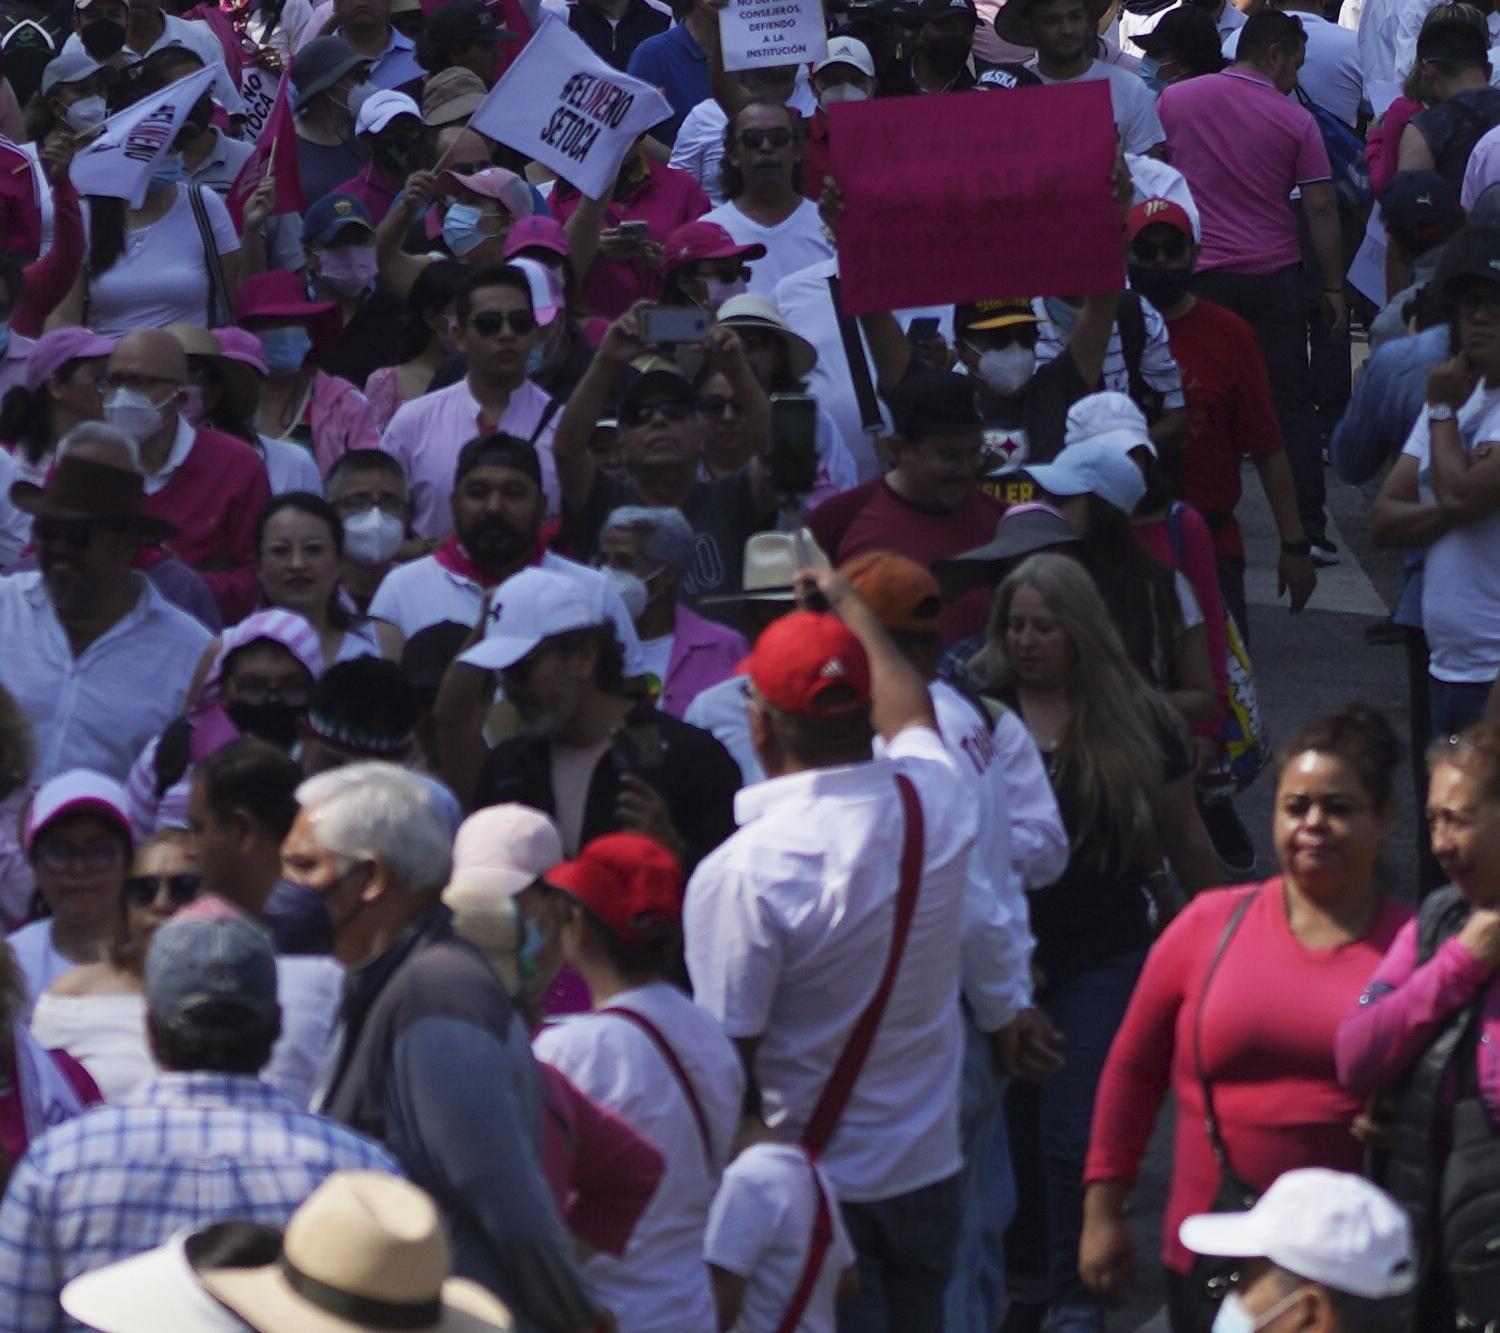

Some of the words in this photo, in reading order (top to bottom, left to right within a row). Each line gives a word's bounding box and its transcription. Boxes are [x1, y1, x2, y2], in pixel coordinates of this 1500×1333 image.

[748, 18, 796, 33] DEFIENDO
[763, 34, 770, 44] A
[772, 34, 785, 44] LA
[746, 43, 807, 59] INSTITUCIÓN
[242, 73, 263, 104] NO
[558, 71, 635, 130] #ELINENO
[540, 104, 601, 164] SETOCA
